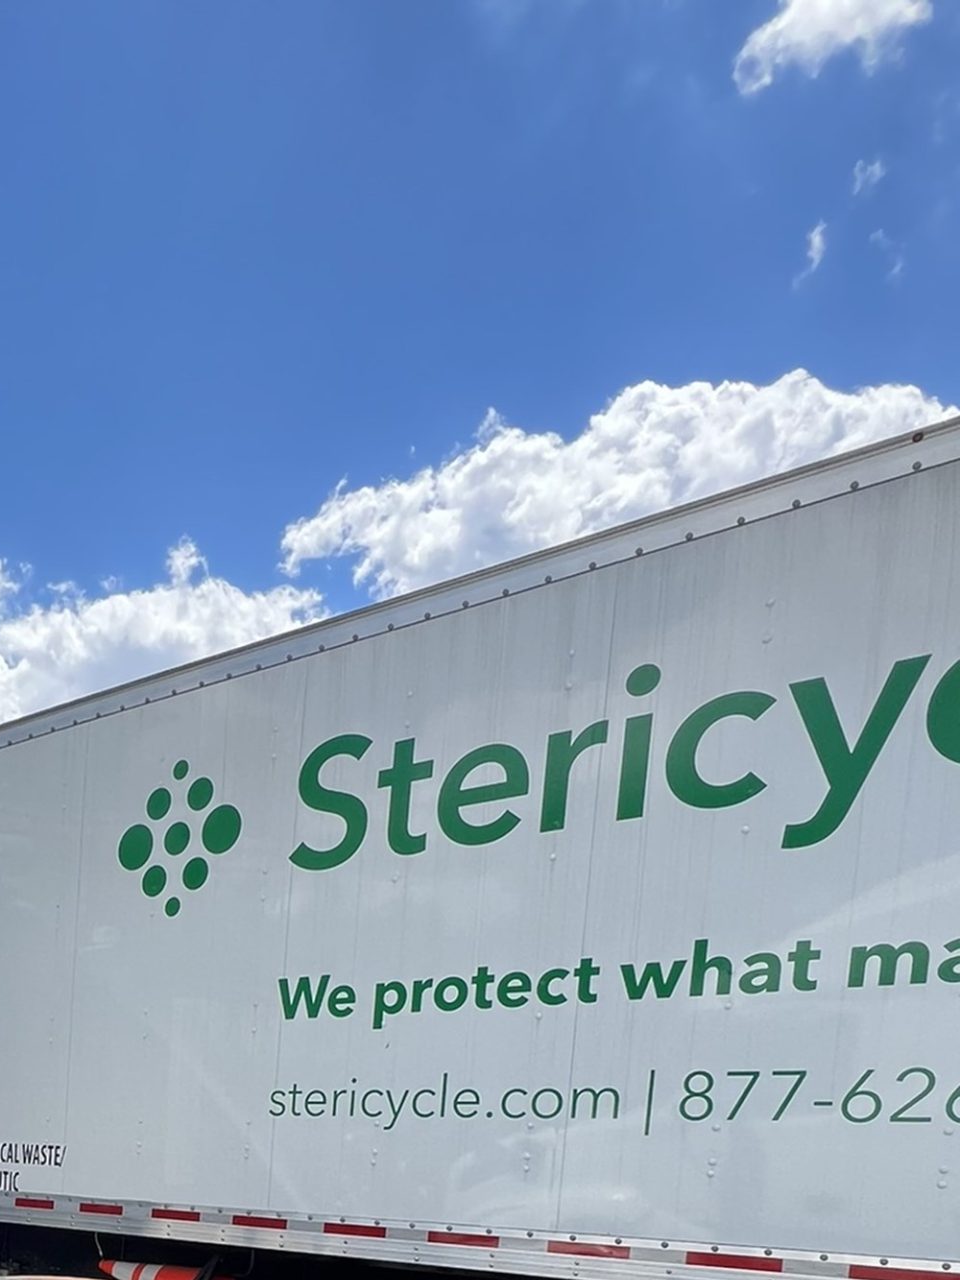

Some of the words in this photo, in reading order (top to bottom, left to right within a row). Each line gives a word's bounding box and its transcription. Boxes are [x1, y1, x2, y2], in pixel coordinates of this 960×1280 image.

[288, 654, 960, 872] Stericy
[277, 973, 356, 1020] We
[372, 957, 601, 1030] protect
[619, 938, 821, 1001] what
[268, 1072, 621, 1130] stericycle.com
[22, 1143, 68, 1167] WASTE/
